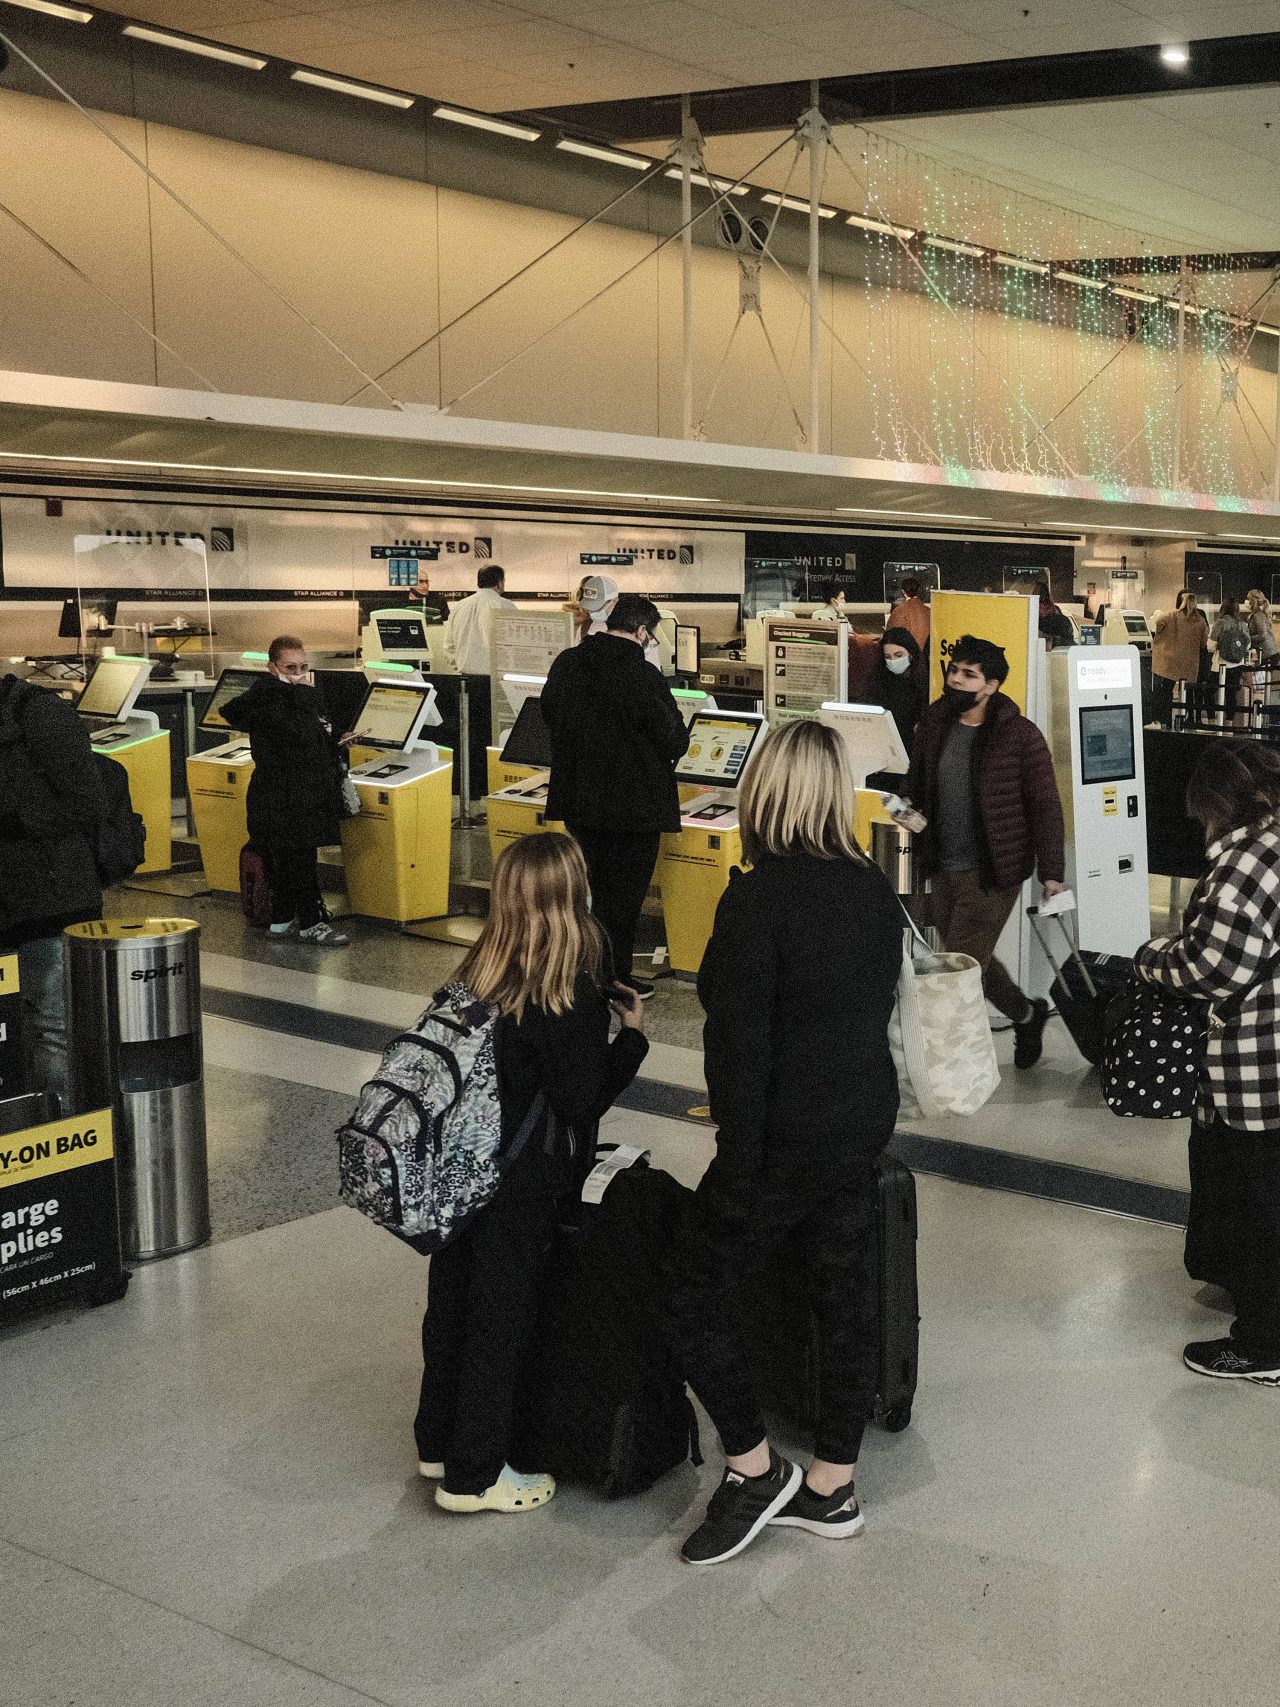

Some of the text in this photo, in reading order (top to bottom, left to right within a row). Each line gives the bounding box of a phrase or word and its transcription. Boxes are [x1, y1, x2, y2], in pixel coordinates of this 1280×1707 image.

[795, 556, 842, 567] UNITED
[130, 962, 185, 982] spirit
[0, 1129, 98, 1169] Y-ON BAG
[1, 1199, 59, 1229] arge
[0, 1226, 63, 1265] plies
[2, 1285, 30, 1299] (56cm
[39, 1274, 62, 1286] 46cm
[70, 1261, 96, 1276] 25cm)
